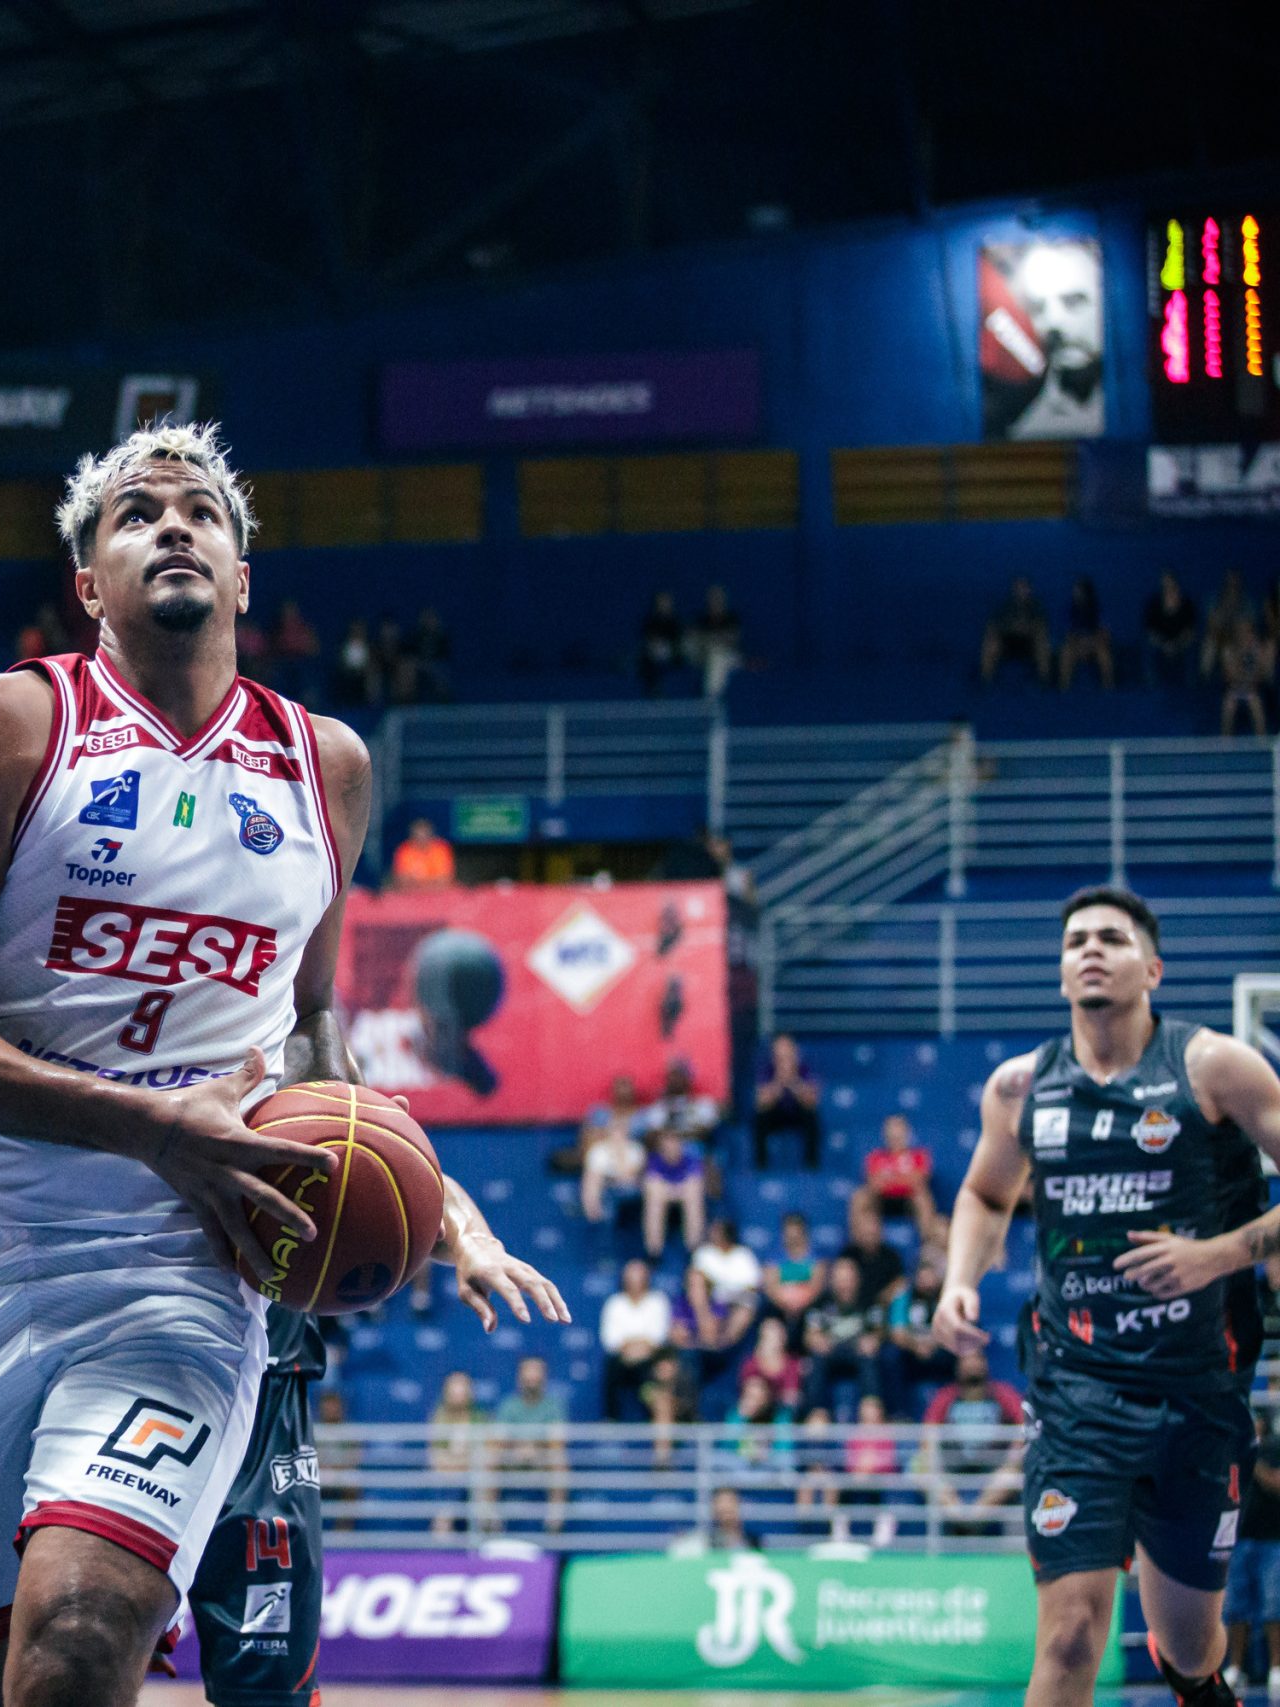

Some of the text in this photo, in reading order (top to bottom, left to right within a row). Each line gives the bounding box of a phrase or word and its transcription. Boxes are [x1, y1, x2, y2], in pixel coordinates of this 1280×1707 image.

[91, 730, 132, 751] SESI
[235, 750, 269, 768] FIESP
[66, 863, 136, 887] Topper
[71, 911, 260, 982] SESI
[117, 990, 176, 1055] 9
[1117, 1299, 1191, 1334] KTO
[85, 1463, 182, 1508] FREEWAY
[244, 1516, 292, 1571] 14
